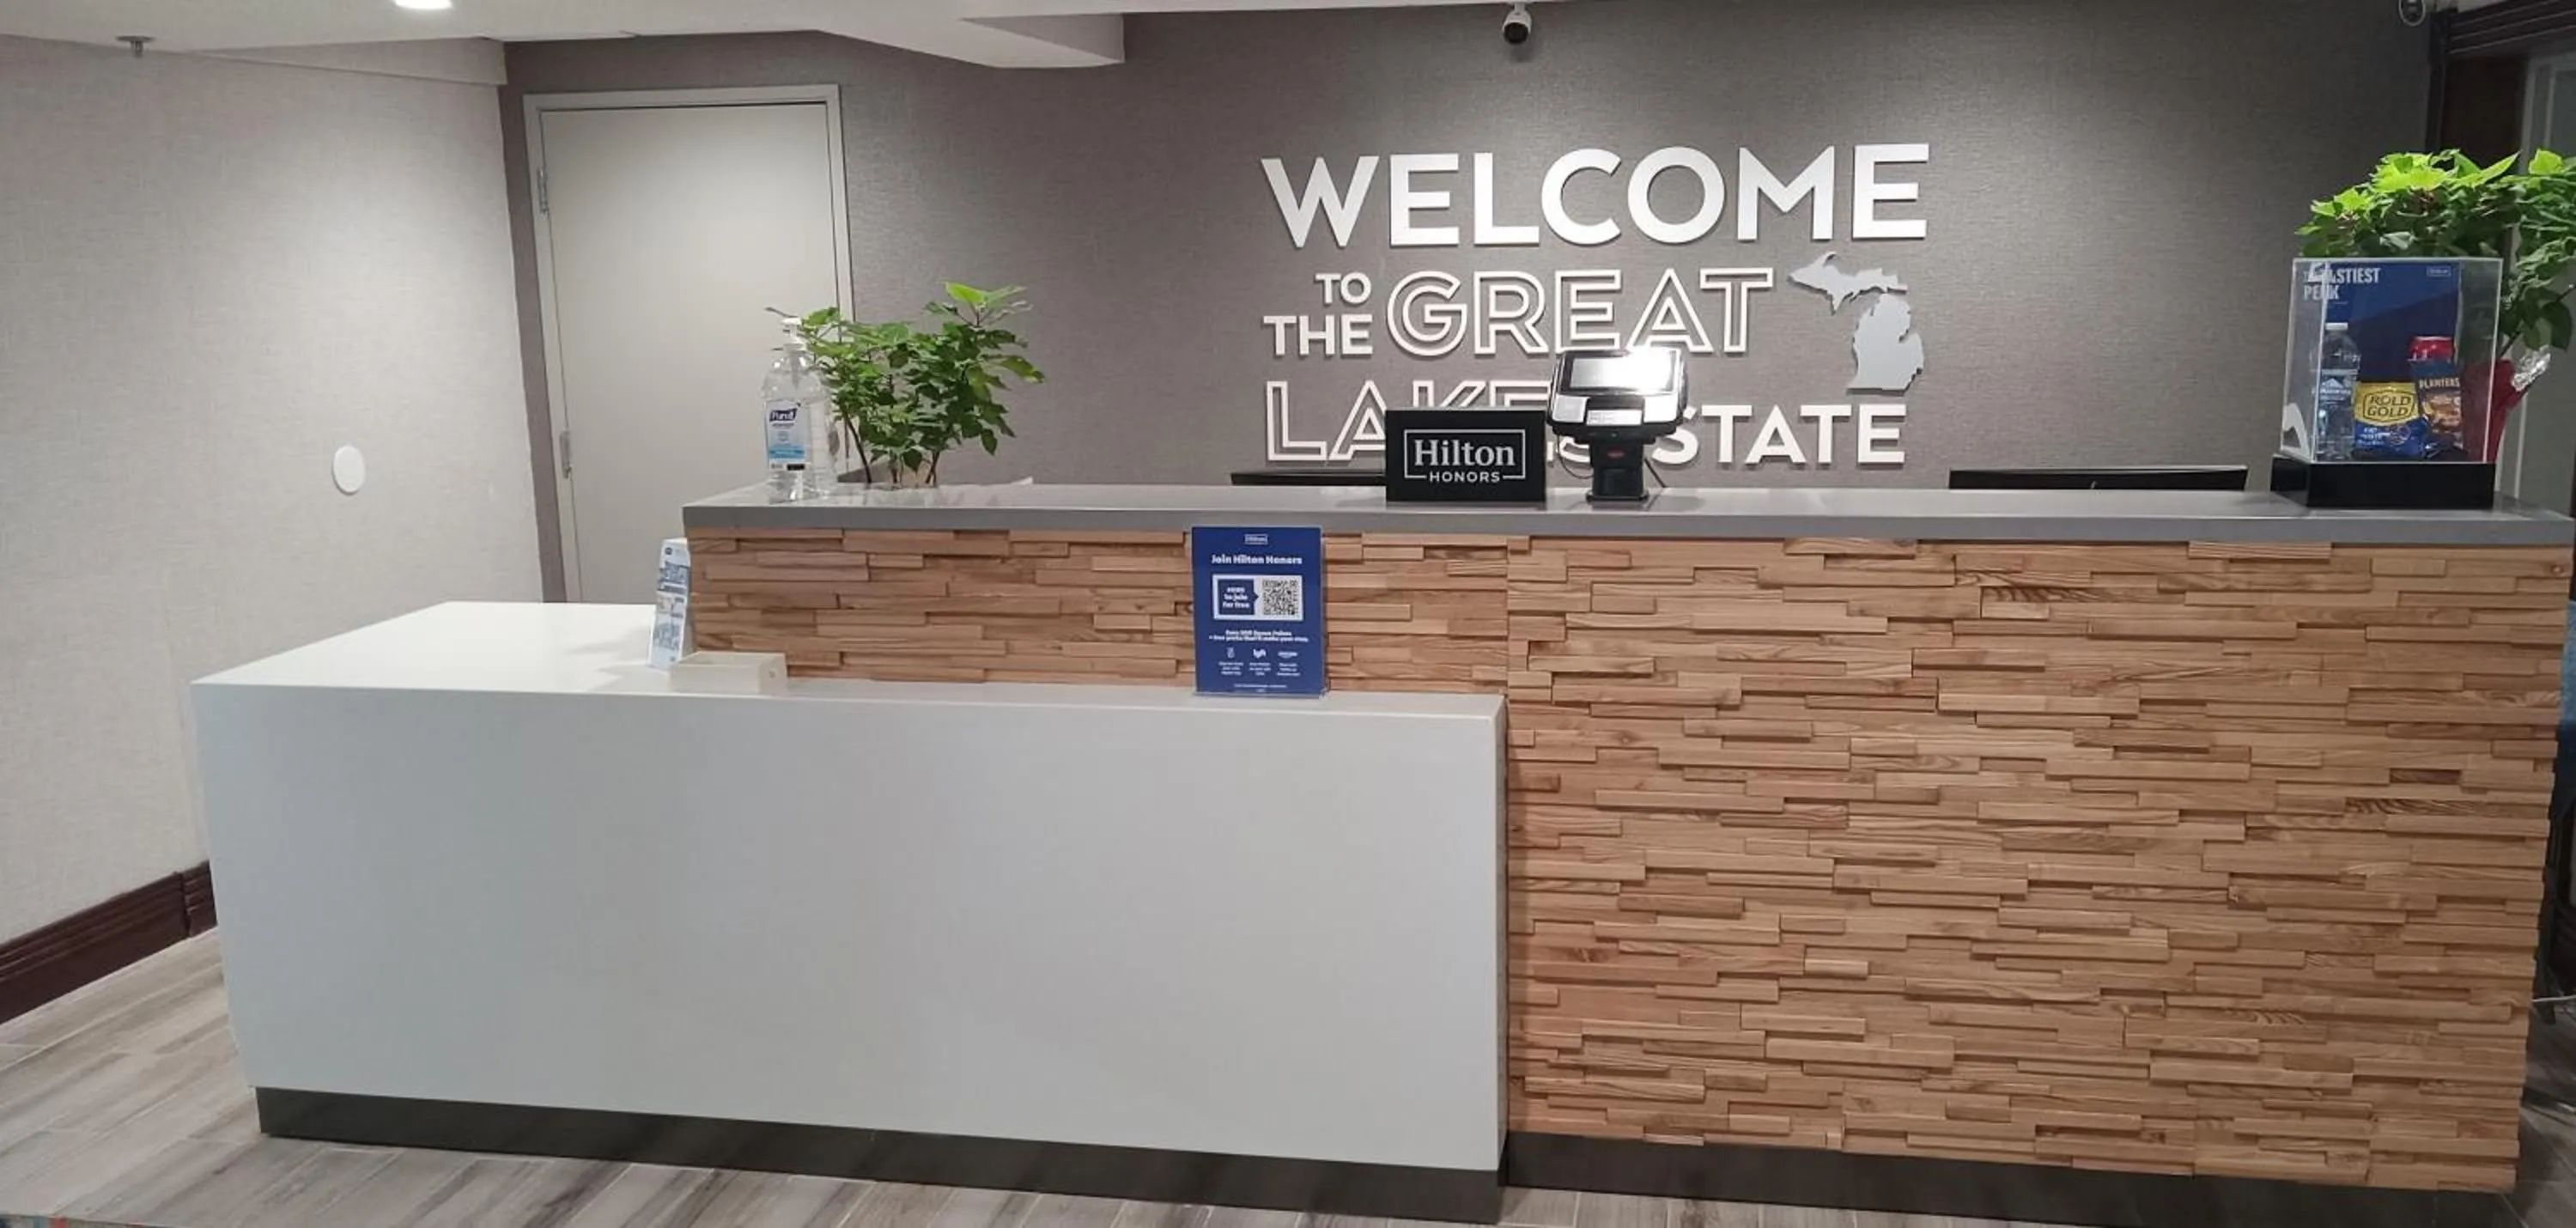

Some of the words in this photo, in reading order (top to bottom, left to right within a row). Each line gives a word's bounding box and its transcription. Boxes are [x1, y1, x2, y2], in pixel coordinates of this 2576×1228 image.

[1261, 143, 1930, 248] WELCOME
[2322, 267, 2381, 283] STIEST
[1315, 271, 1373, 305] TO
[1263, 313, 1374, 356] THE
[1386, 267, 1774, 357] GREAT
[2419, 377, 2460, 389] PLANTERS
[2370, 395, 2411, 406] ROLD
[2367, 406, 2409, 417] GOLD
[1650, 404, 1906, 465] STATE
[1414, 439, 1516, 467] Hilton
[1429, 471, 1501, 483] HONORS
[1212, 554, 1231, 564] Join
[1233, 554, 1265, 564] Hilton
[1266, 555, 1303, 565] Honors
